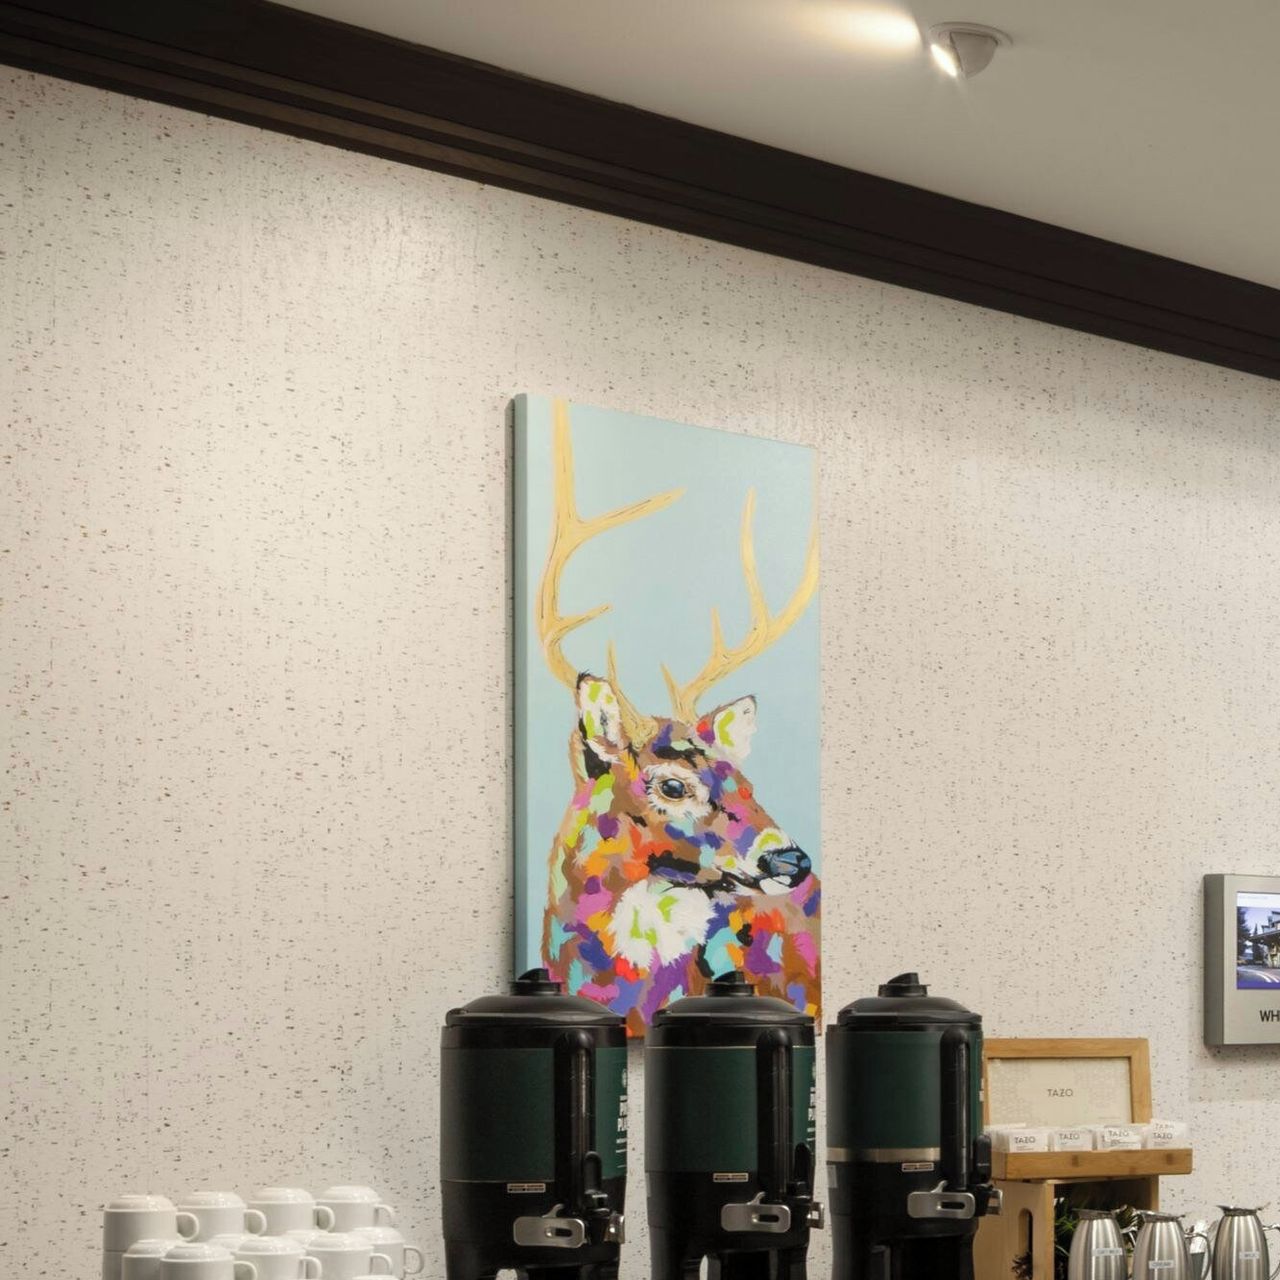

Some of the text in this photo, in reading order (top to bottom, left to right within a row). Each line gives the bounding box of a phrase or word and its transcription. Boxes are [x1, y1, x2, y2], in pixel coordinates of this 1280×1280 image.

[1047, 1088, 1073, 1098] TAZO
[1014, 1136, 1036, 1144] TAZO
[1059, 1132, 1080, 1141] TAZO
[1153, 1132, 1173, 1140] TAZO
